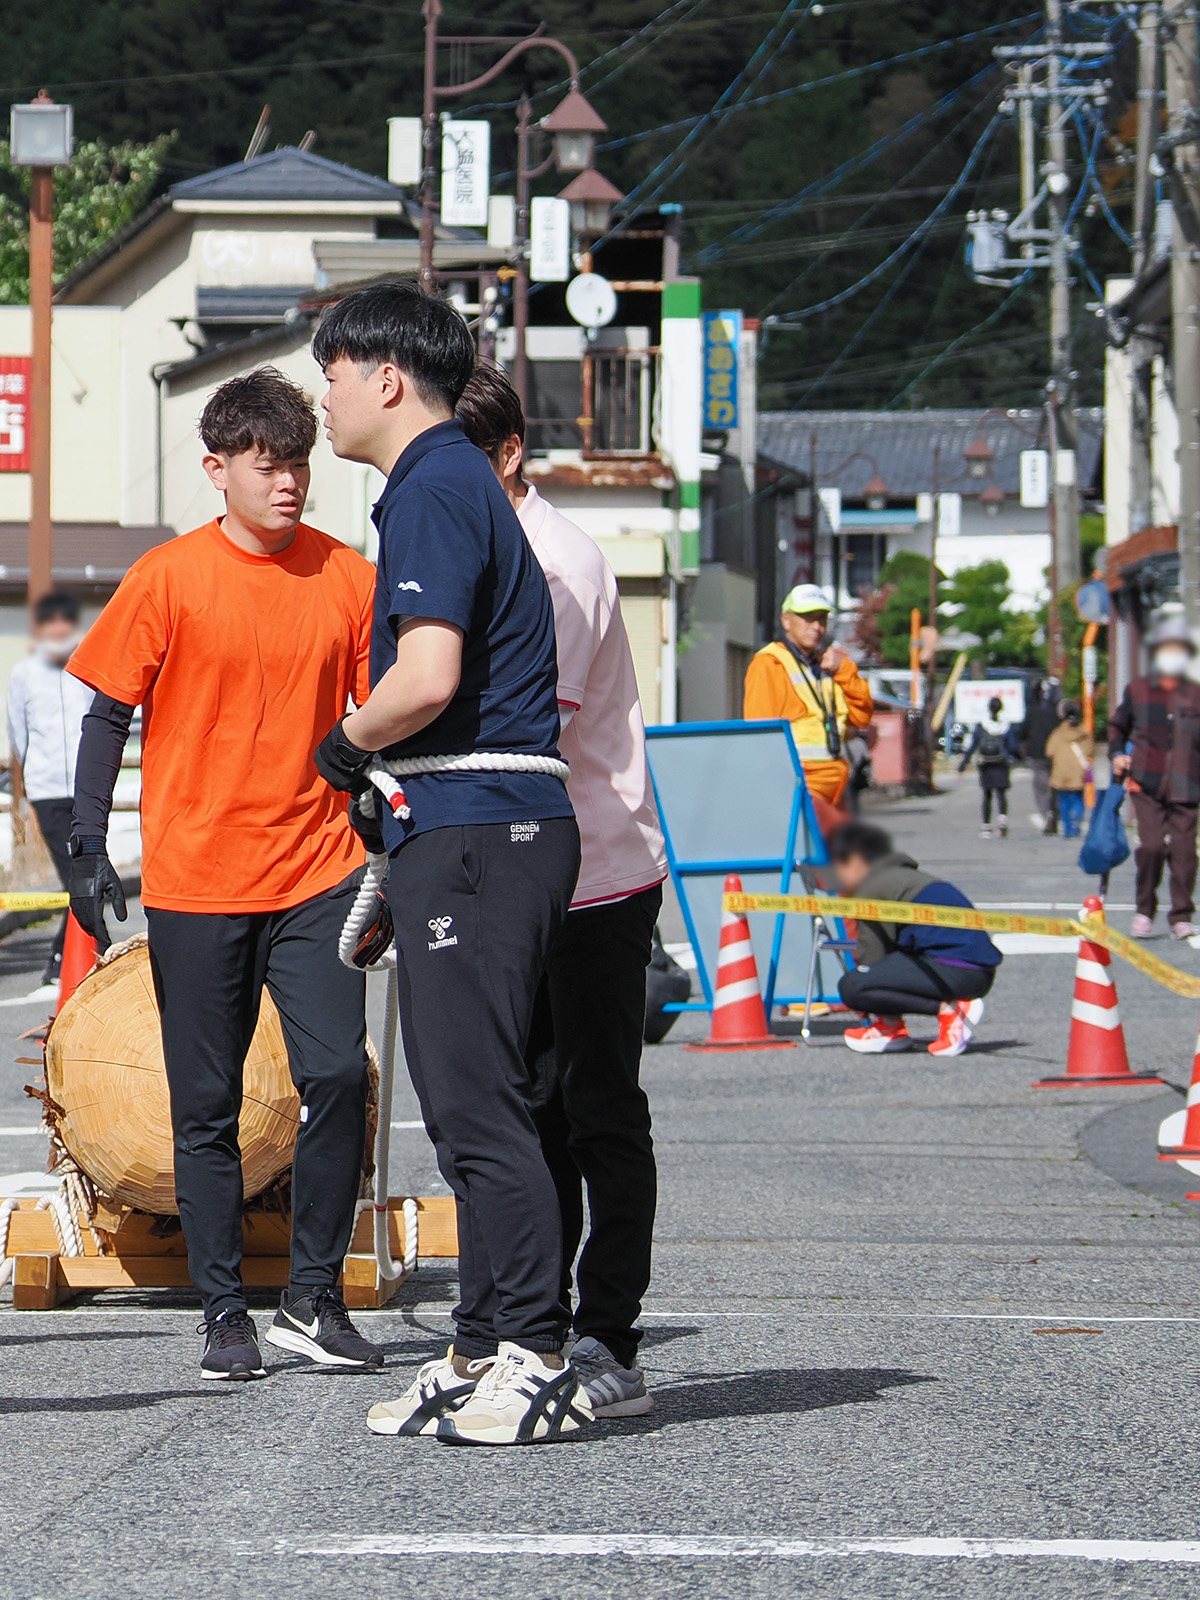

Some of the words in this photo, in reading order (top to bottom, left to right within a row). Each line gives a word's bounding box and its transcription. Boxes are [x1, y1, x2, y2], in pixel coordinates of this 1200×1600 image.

[510, 824, 540, 833] GENNEM
[510, 833, 535, 842] SPORT
[428, 935, 458, 951] hummel
